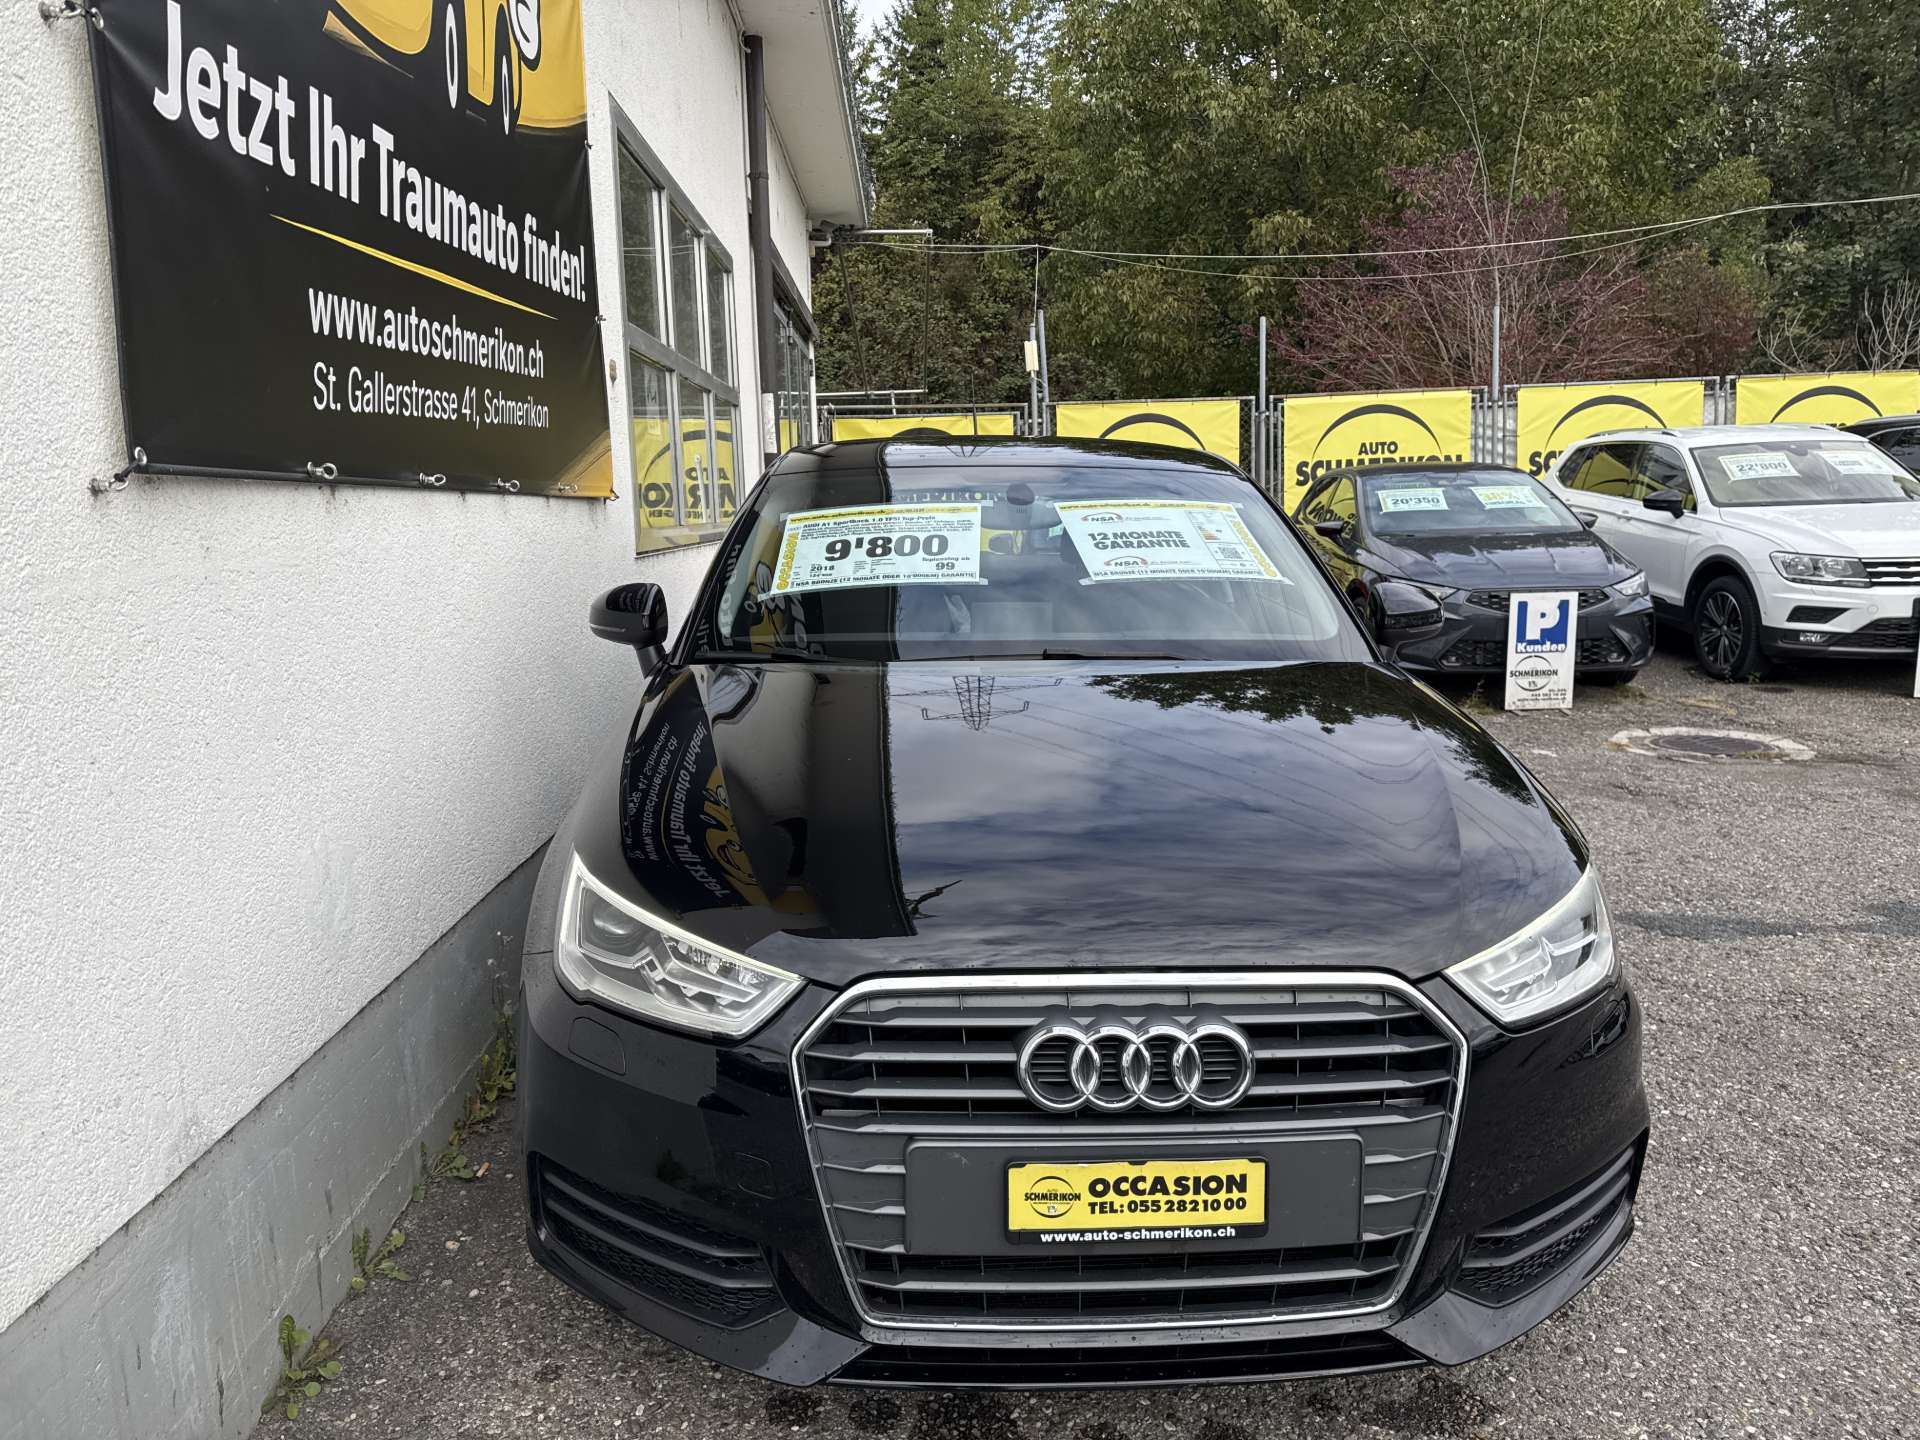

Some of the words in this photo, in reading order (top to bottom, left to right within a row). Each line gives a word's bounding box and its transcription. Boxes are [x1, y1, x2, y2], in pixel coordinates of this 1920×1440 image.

[153, 0, 296, 177] Jetzt
[309, 86, 366, 204] Ihr
[372, 123, 519, 273] Traumauto
[523, 212, 586, 302] finden!
[308, 287, 544, 379] www.autoschmerikon.ch
[313, 361, 341, 411] St.
[347, 365, 458, 421] Gallerstrasse
[461, 387, 480, 430] 41,
[483, 388, 549, 429] Schmerikon
[1358, 441, 1399, 455] AUTO
[1088, 532, 1110, 541] 12
[1112, 530, 1185, 541] MONATE
[824, 534, 949, 562] 9'800
[1094, 539, 1191, 550] GARANTIE
[810, 564, 835, 572] 2018
[935, 561, 955, 570] 99
[1526, 599, 1560, 640] P
[1516, 641, 1567, 653] Kunden
[1509, 669, 1558, 678] SCHMERIKON
[1088, 1173, 1248, 1198] OCCASION
[1024, 1192, 1081, 1202] SCHMERIKON
[1088, 1201, 1124, 1214] TEL:
[1040, 1227, 1236, 1243] www.auto-schmerikon.ch
